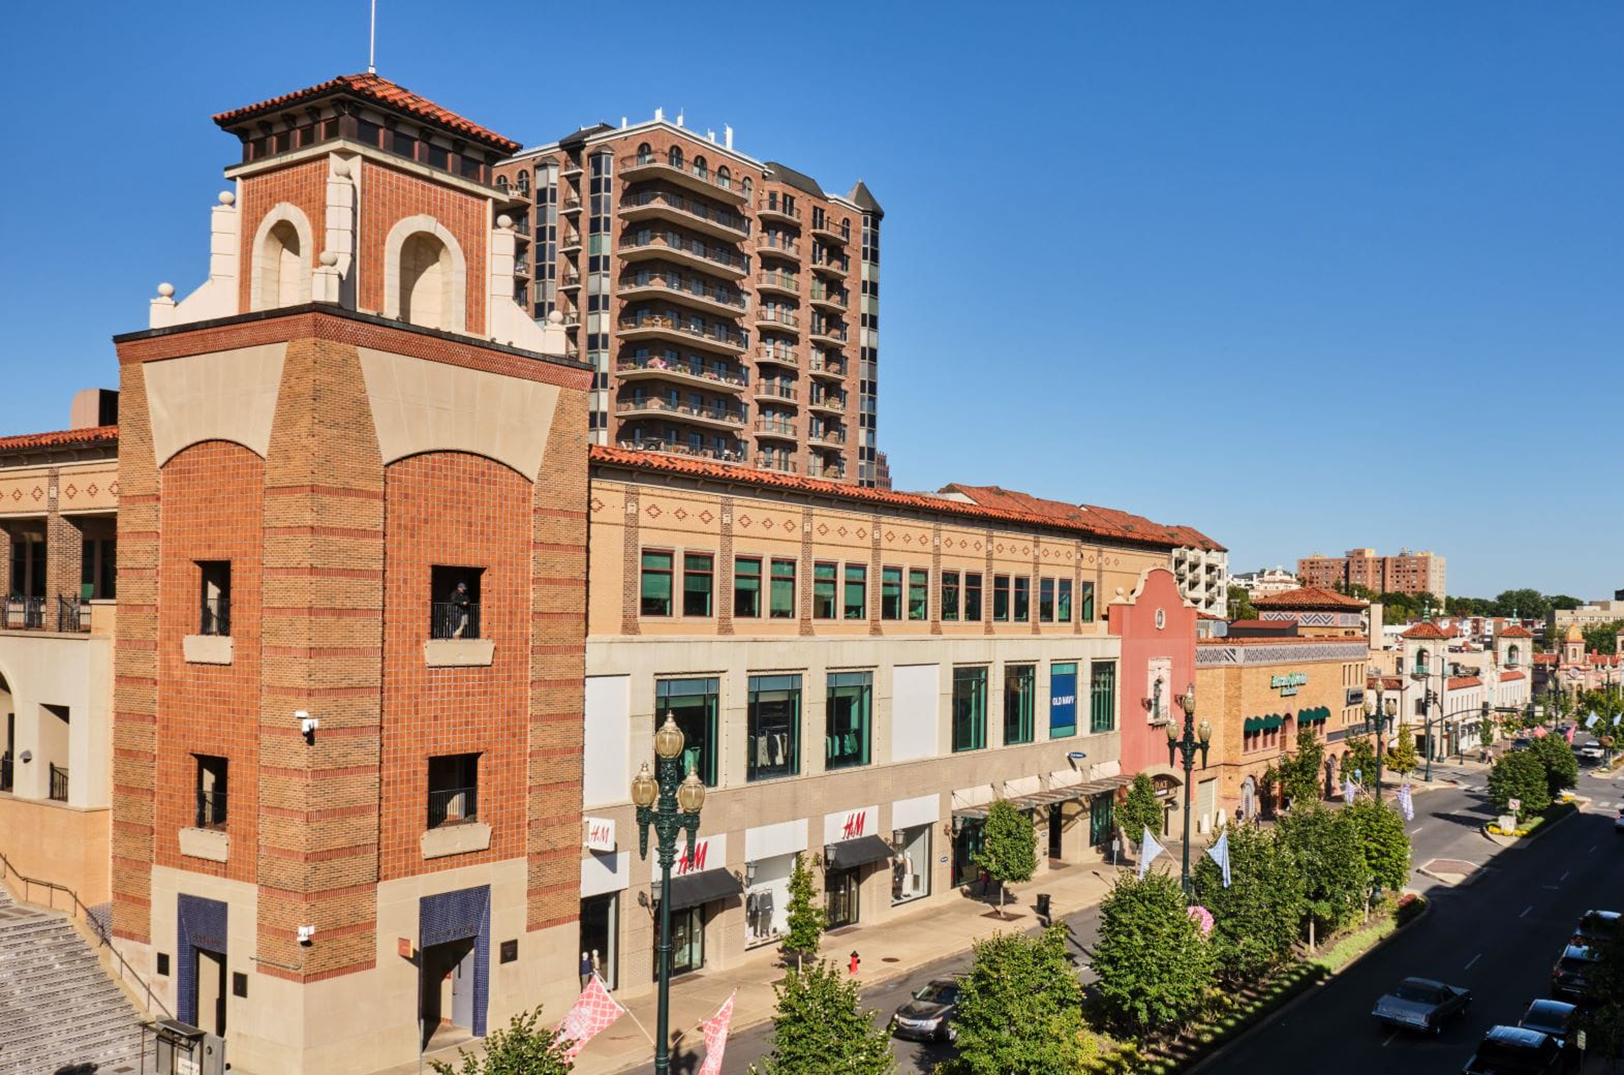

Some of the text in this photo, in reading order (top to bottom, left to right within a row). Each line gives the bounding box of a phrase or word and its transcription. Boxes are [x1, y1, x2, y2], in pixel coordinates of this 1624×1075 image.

[1052, 695, 1074, 706] OLD NAVY
[590, 825, 610, 844] H&M
[843, 811, 865, 839] H&M
